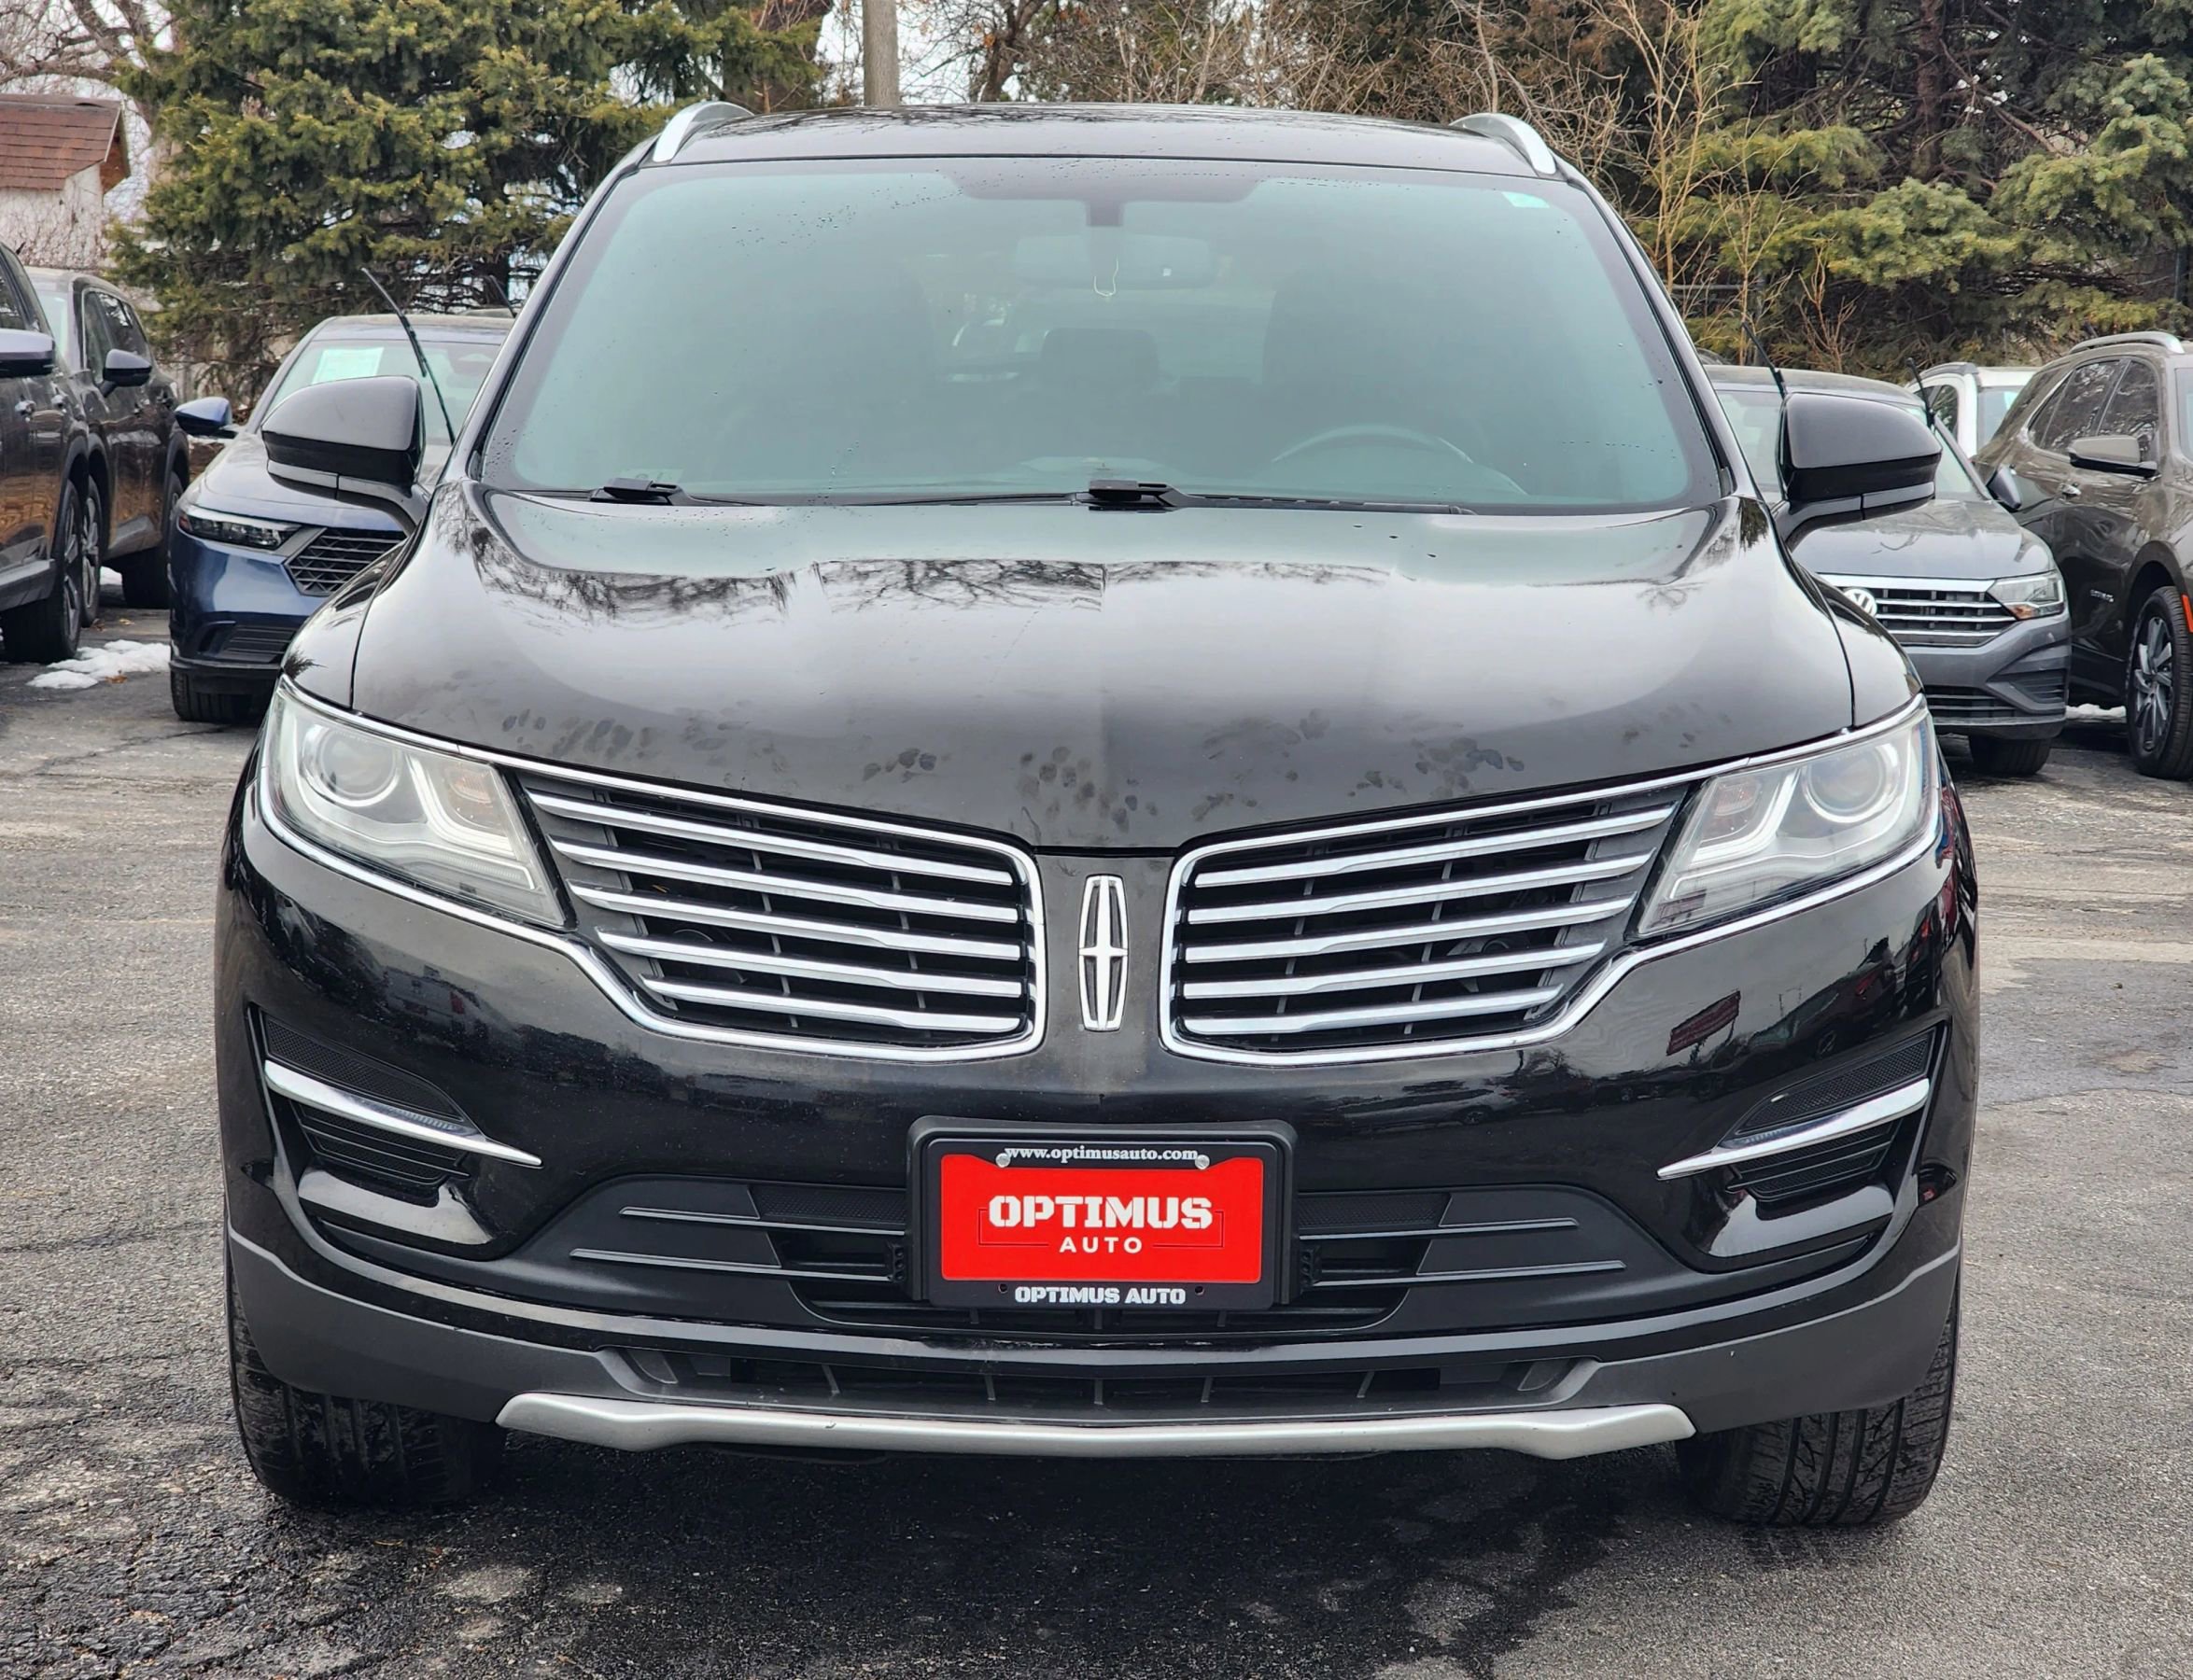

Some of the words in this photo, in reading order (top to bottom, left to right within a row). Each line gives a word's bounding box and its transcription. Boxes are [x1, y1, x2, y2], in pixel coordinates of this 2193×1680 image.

[1005, 1145, 1198, 1163] www.optimusauto.com
[989, 1196, 1213, 1229] OPTIMUS
[1059, 1237, 1143, 1253] AUTO
[1015, 1286, 1120, 1304] OPTIMUS
[1124, 1288, 1186, 1304] AUTO
